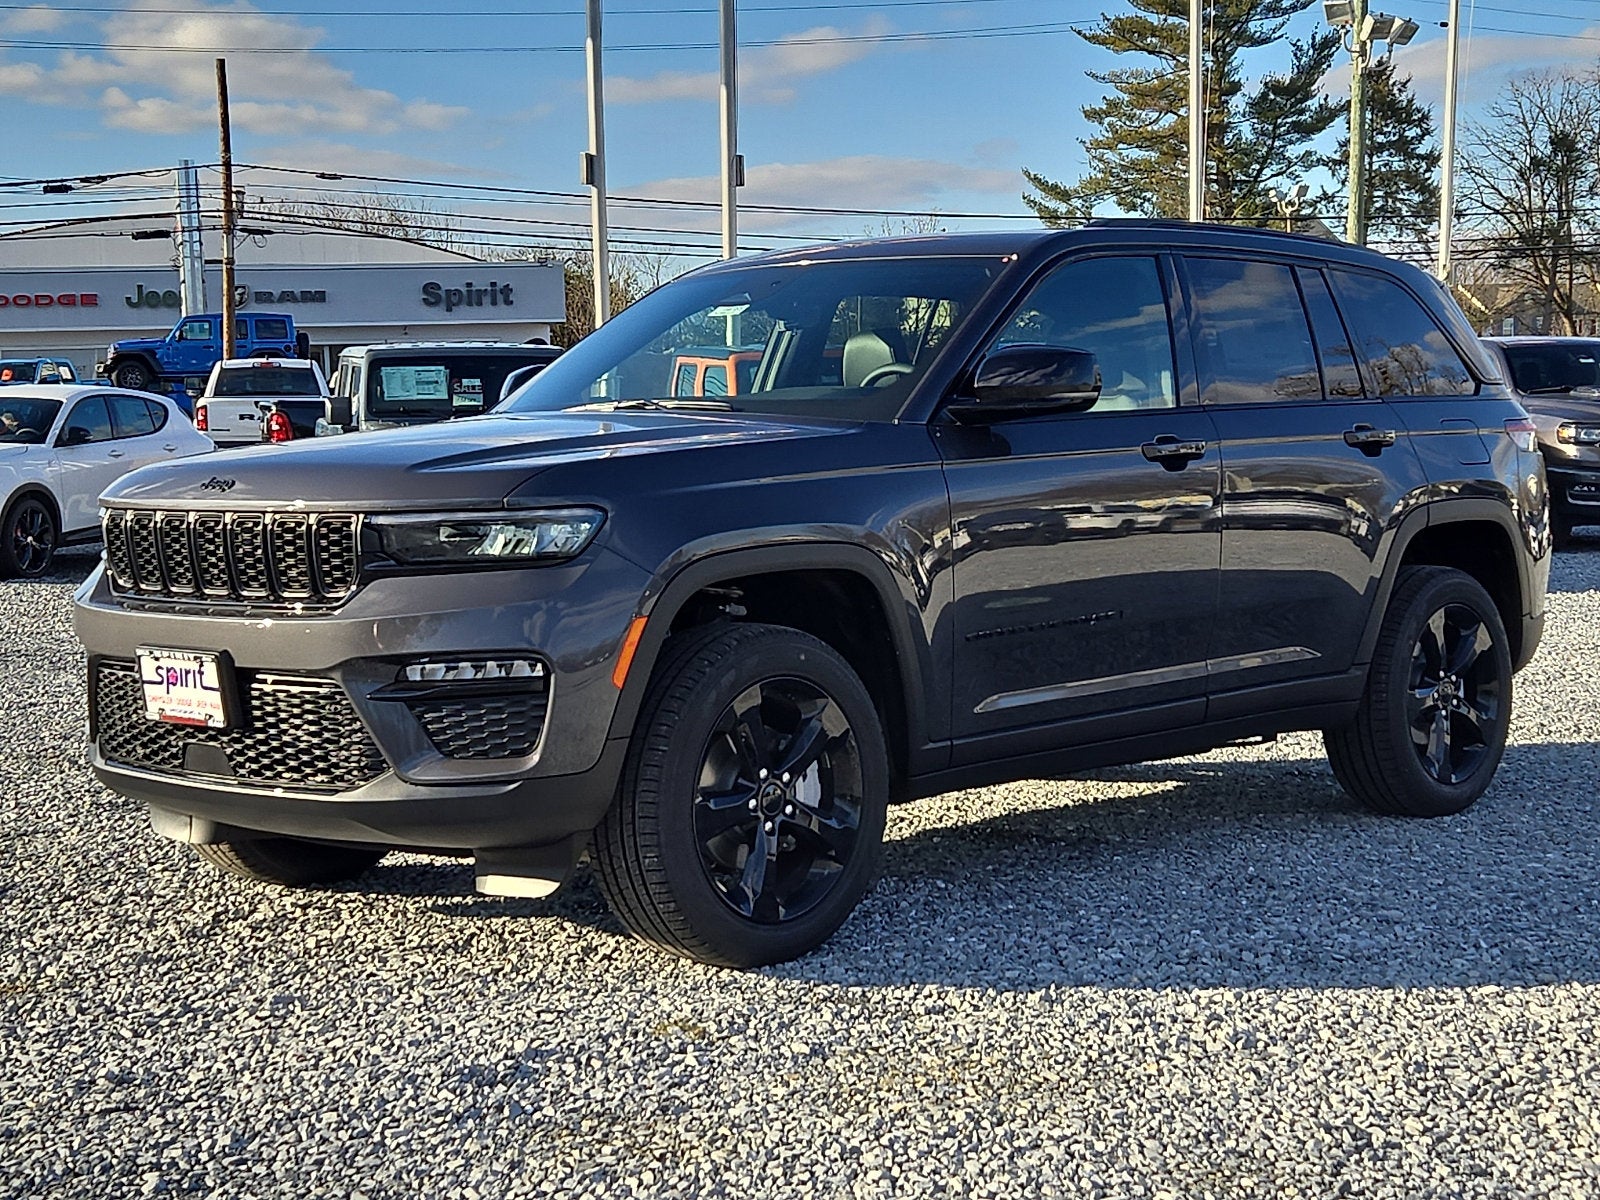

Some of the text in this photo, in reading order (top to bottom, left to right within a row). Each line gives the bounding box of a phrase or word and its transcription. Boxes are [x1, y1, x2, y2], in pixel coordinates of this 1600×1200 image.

[125, 283, 181, 309] Jee
[254, 290, 326, 303] RAM
[422, 281, 514, 312] Spirit
[453, 383, 483, 393] SALE
